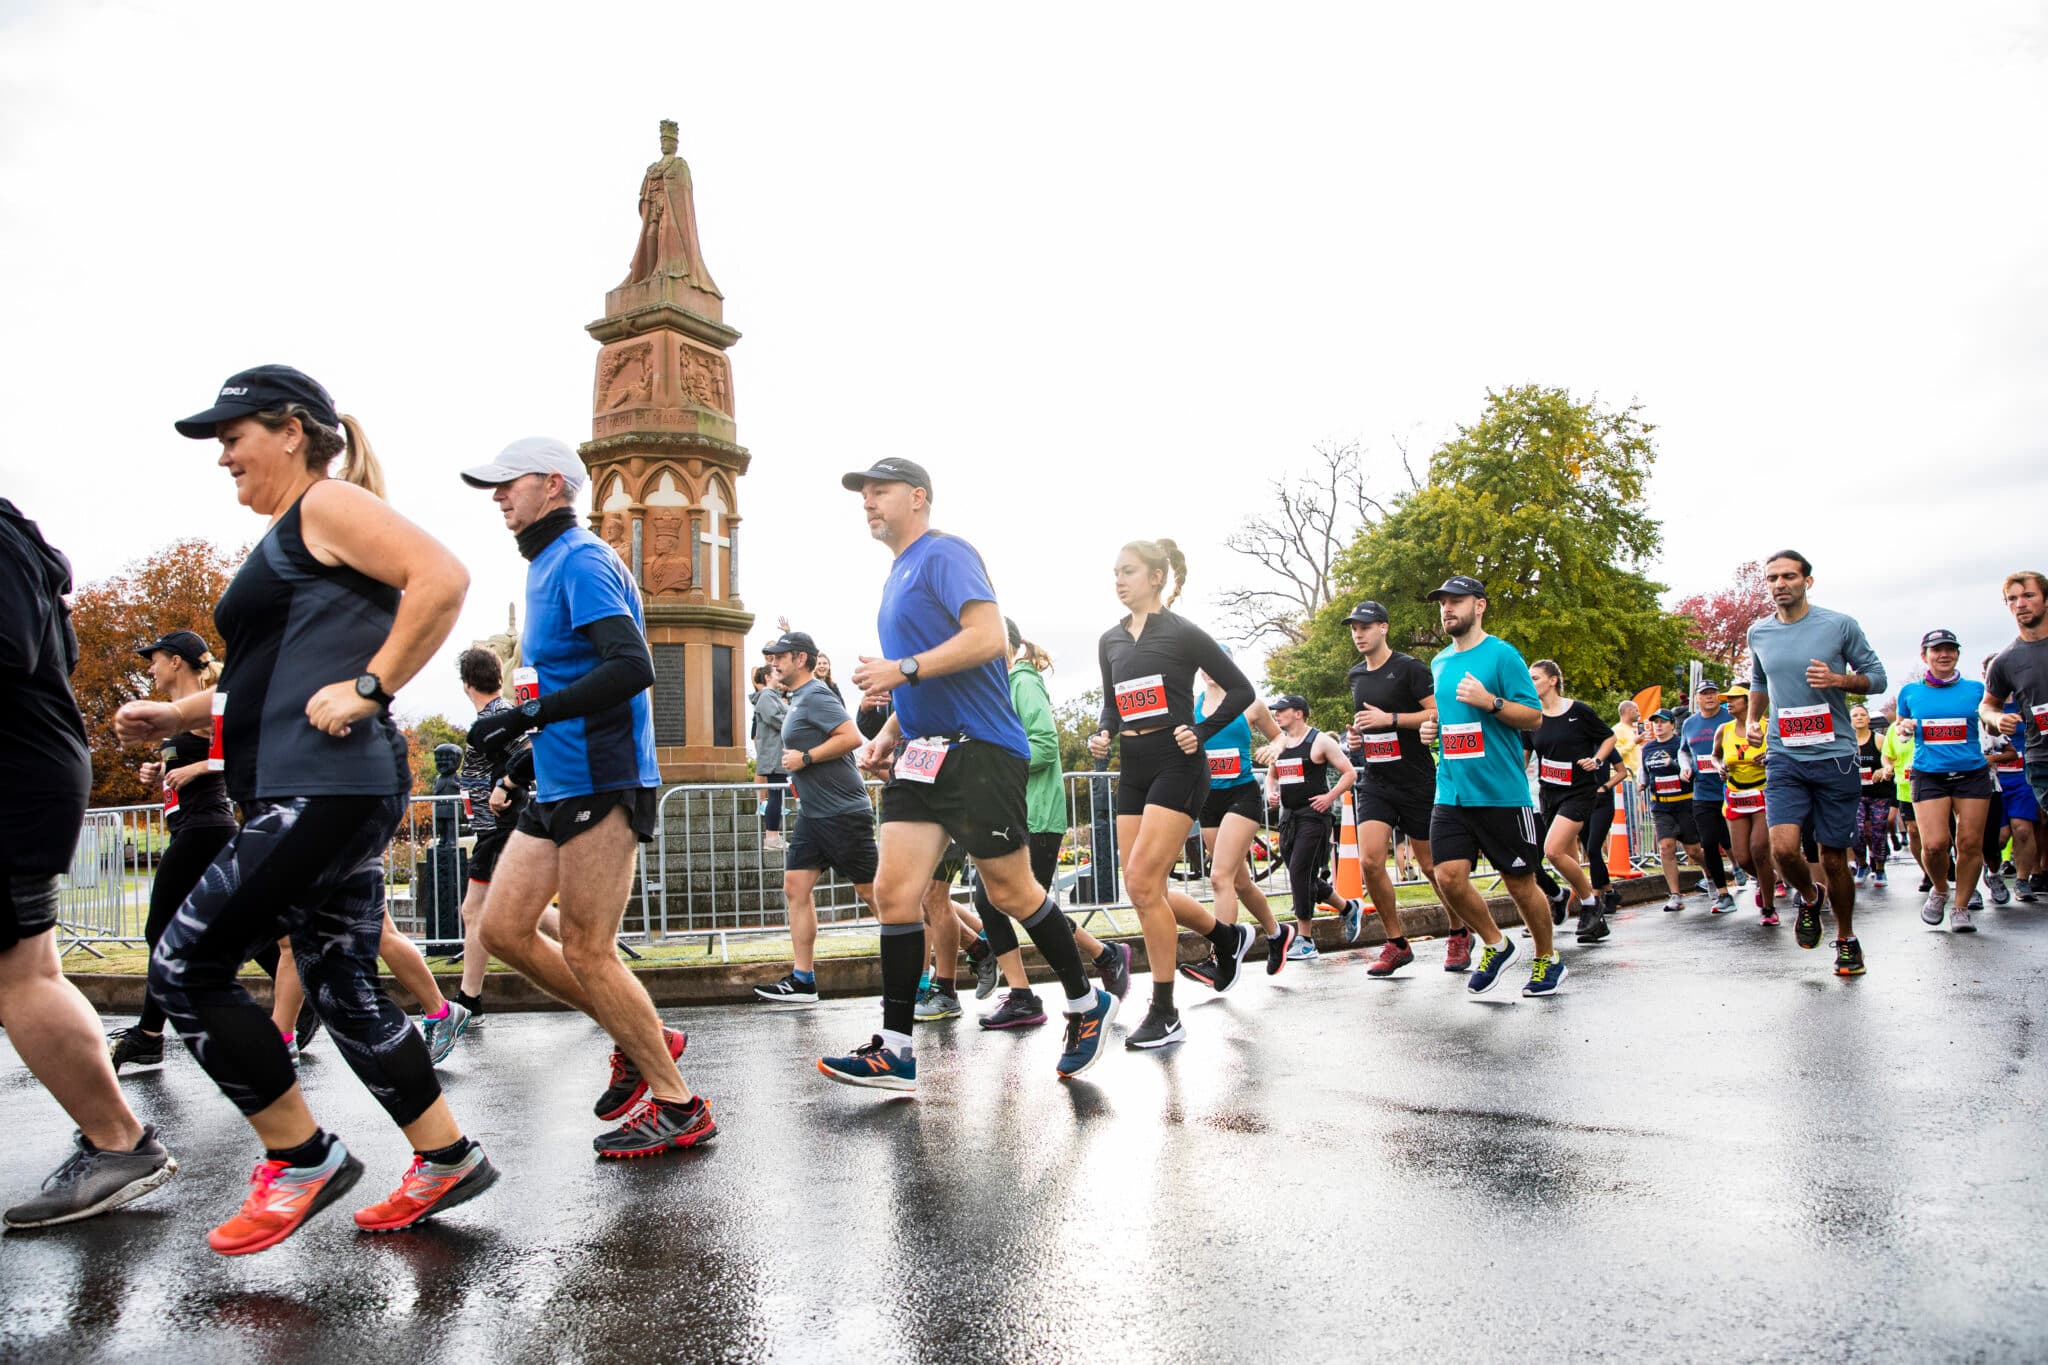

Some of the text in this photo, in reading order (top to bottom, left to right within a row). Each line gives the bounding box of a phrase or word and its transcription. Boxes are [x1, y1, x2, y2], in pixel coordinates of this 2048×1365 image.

[1120, 688, 1158, 711] 2195
[1784, 715, 1825, 733] 3928
[1444, 734, 1477, 749] 2278
[1207, 757, 1234, 771] 247
